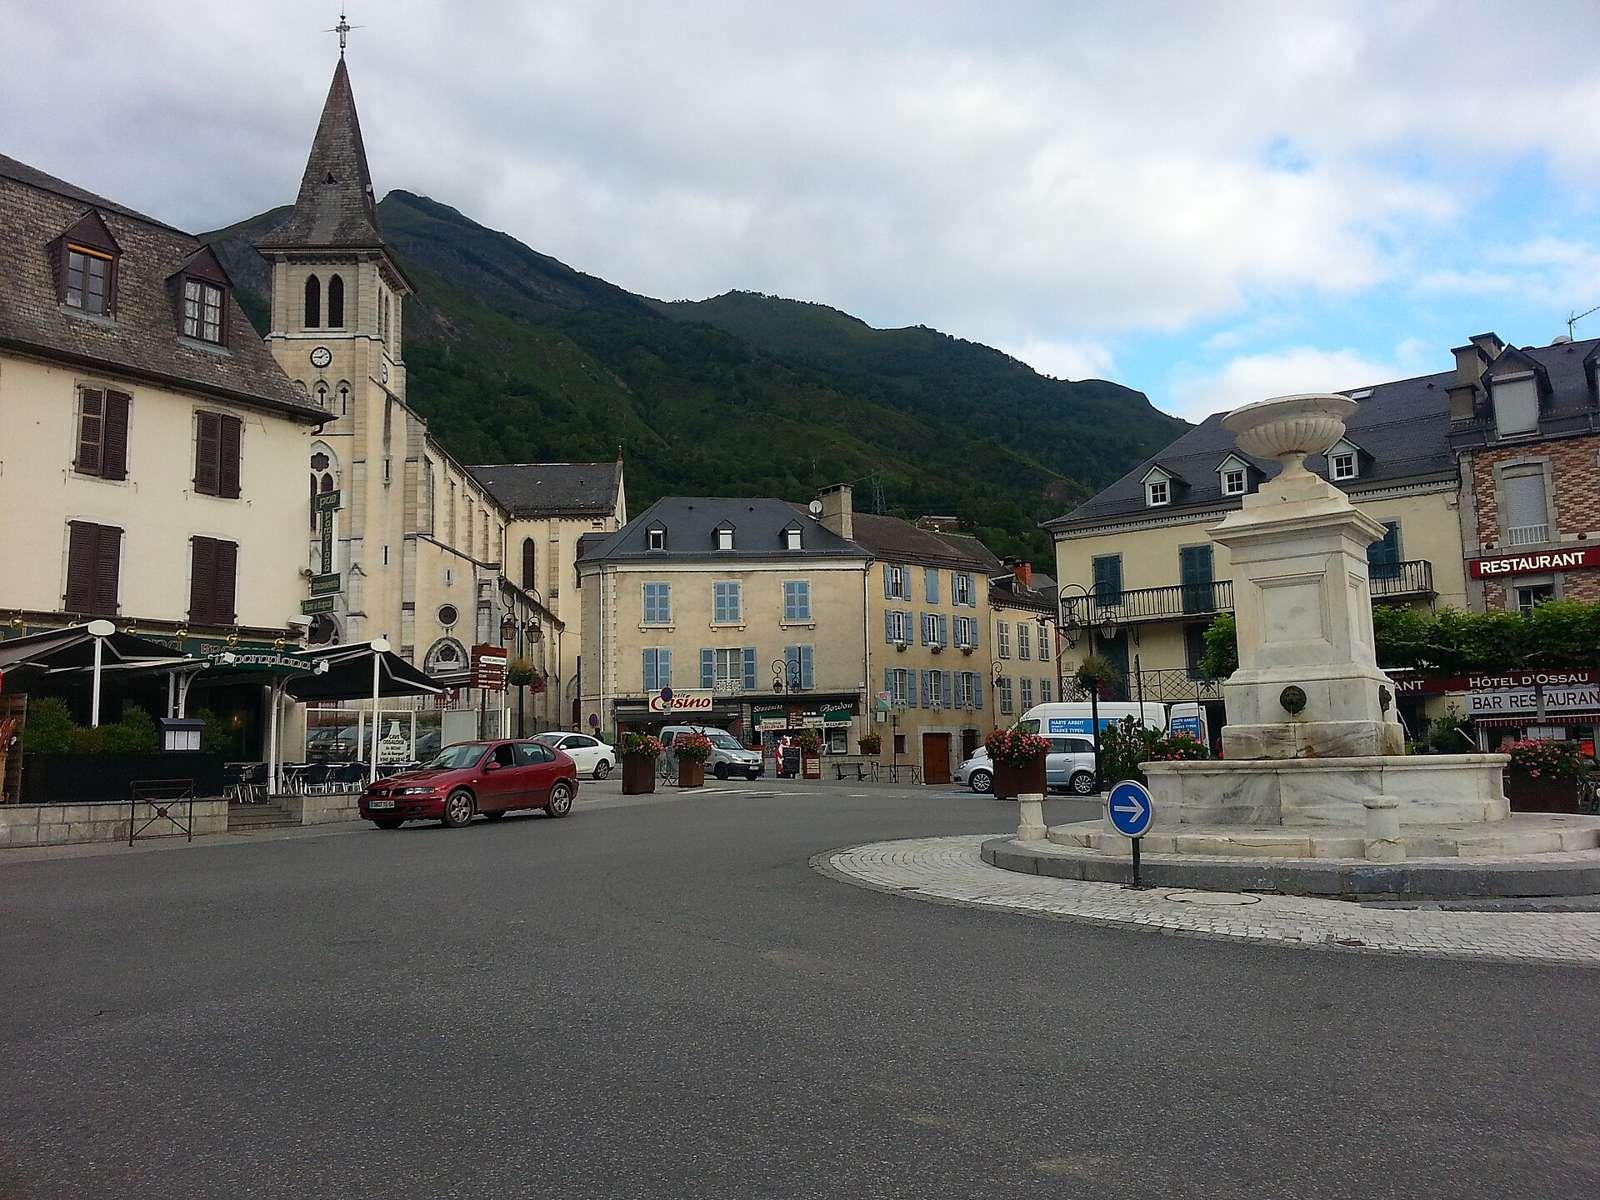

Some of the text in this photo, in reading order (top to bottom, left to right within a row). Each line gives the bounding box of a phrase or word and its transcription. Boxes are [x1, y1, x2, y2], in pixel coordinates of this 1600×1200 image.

[1480, 552, 1585, 574] RESTAURANT
[1469, 675, 1518, 688] HÔTEL
[1472, 691, 1600, 710] BAR RESAURAN
